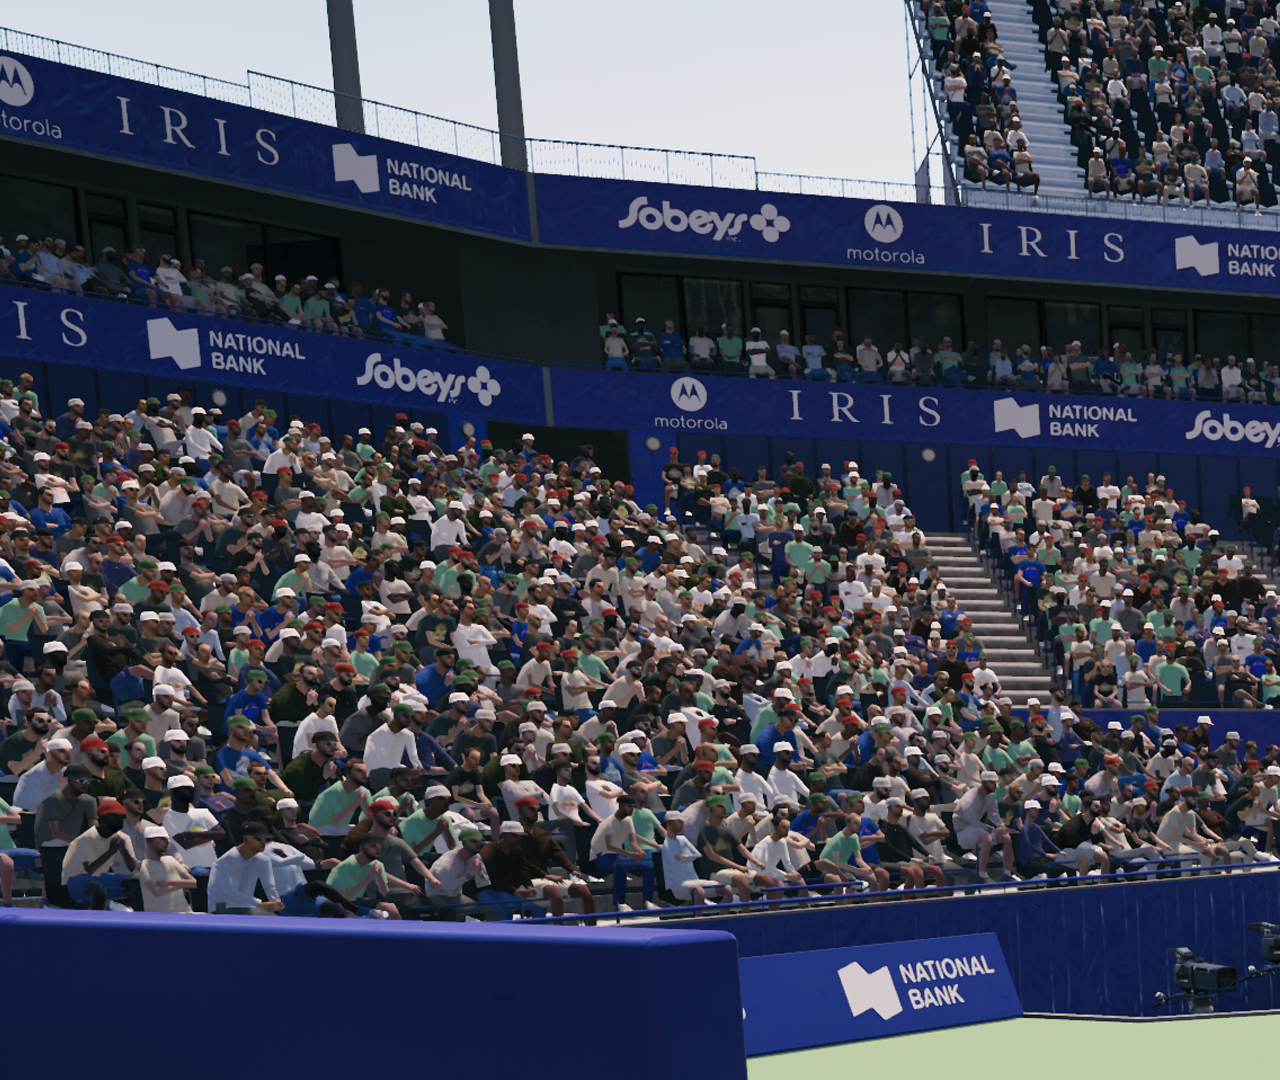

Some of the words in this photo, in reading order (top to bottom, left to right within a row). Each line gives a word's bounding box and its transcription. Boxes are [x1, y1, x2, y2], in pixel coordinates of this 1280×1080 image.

[1, 110, 61, 138] torola
[118, 97, 278, 164] IRIS
[387, 158, 471, 192] NATIONAL
[389, 179, 437, 203] BANK
[619, 197, 747, 241] Sobeys
[847, 247, 924, 264] motorola
[980, 224, 1124, 262] IRIS
[1229, 261, 1275, 277] BANK
[209, 331, 306, 359] NATIONAL
[211, 352, 266, 375] BANK
[357, 353, 465, 403] Sobeys
[655, 415, 727, 429] motorola
[789, 390, 940, 426] IRIS
[1049, 404, 1137, 422] NATIONAL
[1050, 422, 1099, 437] BANK
[899, 955, 995, 983] NATIONAL
[908, 984, 965, 1009] BANK
